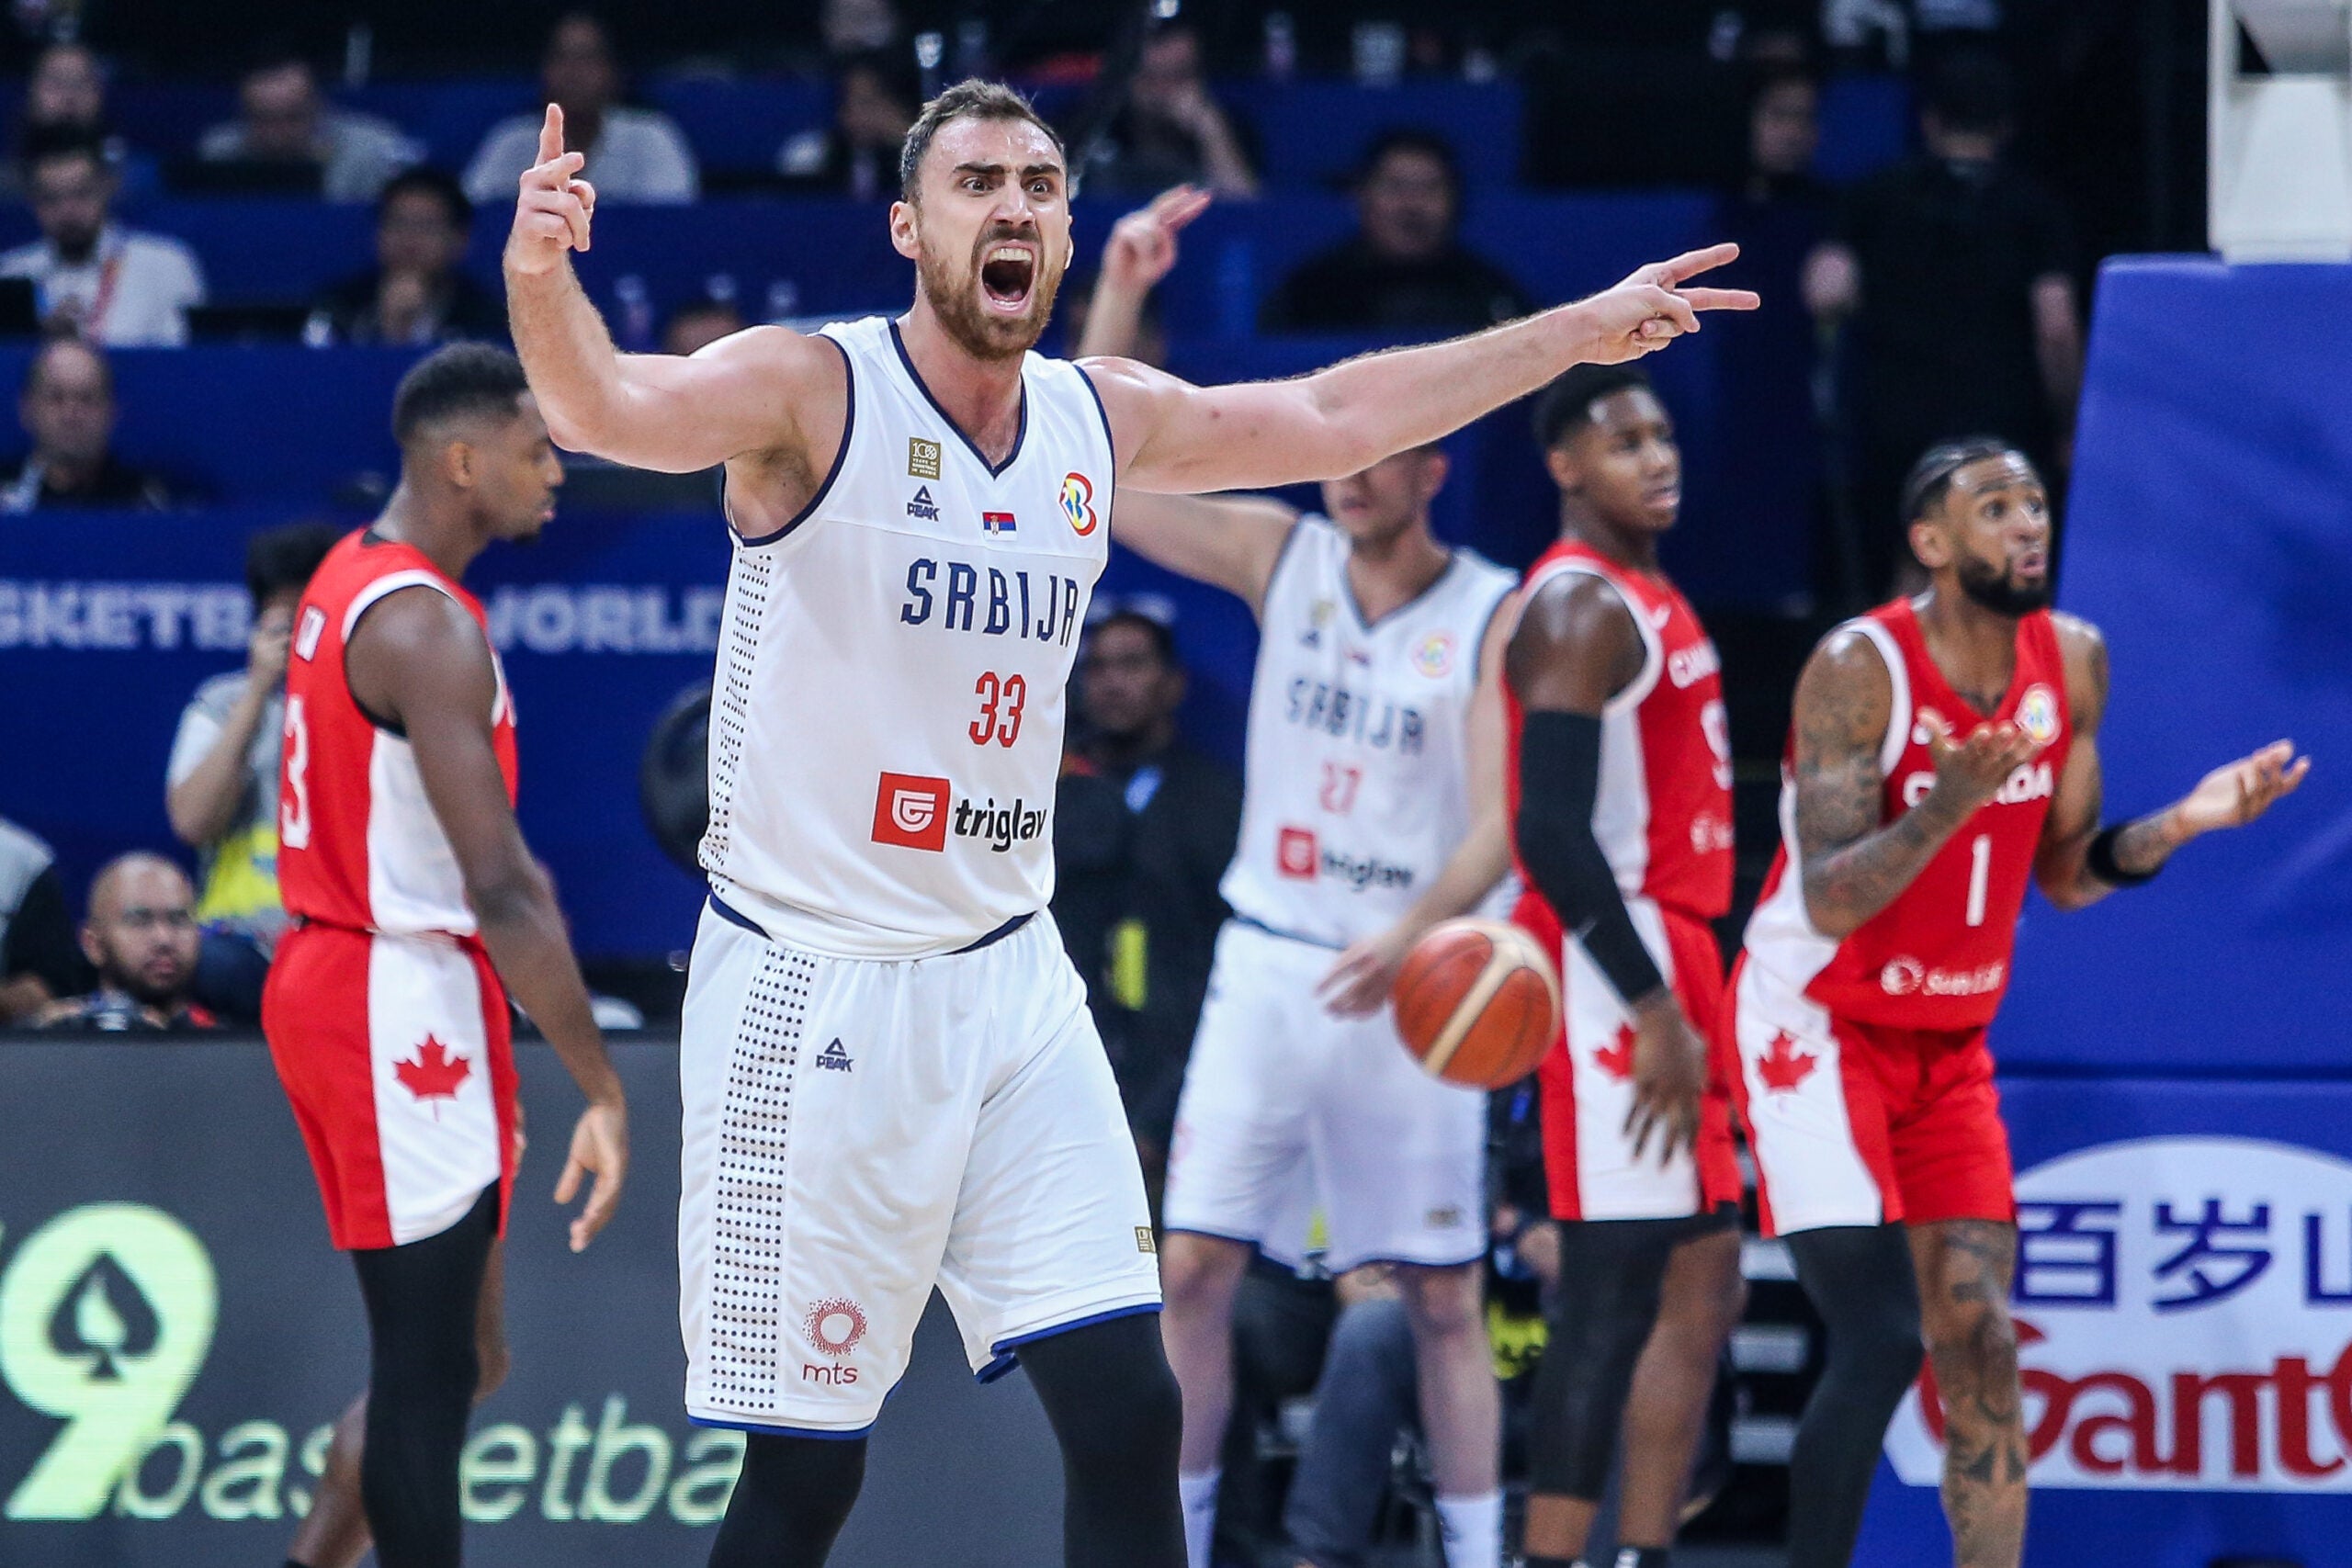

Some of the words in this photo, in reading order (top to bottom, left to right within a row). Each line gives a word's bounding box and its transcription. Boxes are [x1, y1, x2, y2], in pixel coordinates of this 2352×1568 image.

[906, 502, 940, 522] PEAK
[899, 558, 1079, 648] SRBIJA
[968, 671, 1026, 749] 33
[1288, 677, 1425, 757] SRBIJA
[1318, 761, 1362, 816] 27
[1903, 761, 2053, 808] CDA
[954, 797, 1047, 853] triglav
[1965, 833, 1992, 928] 1
[816, 1055, 854, 1073] PEAK
[802, 1362, 858, 1385] mts
[1914, 1317, 2352, 1481] ant
[116, 1393, 746, 1527] basetba
